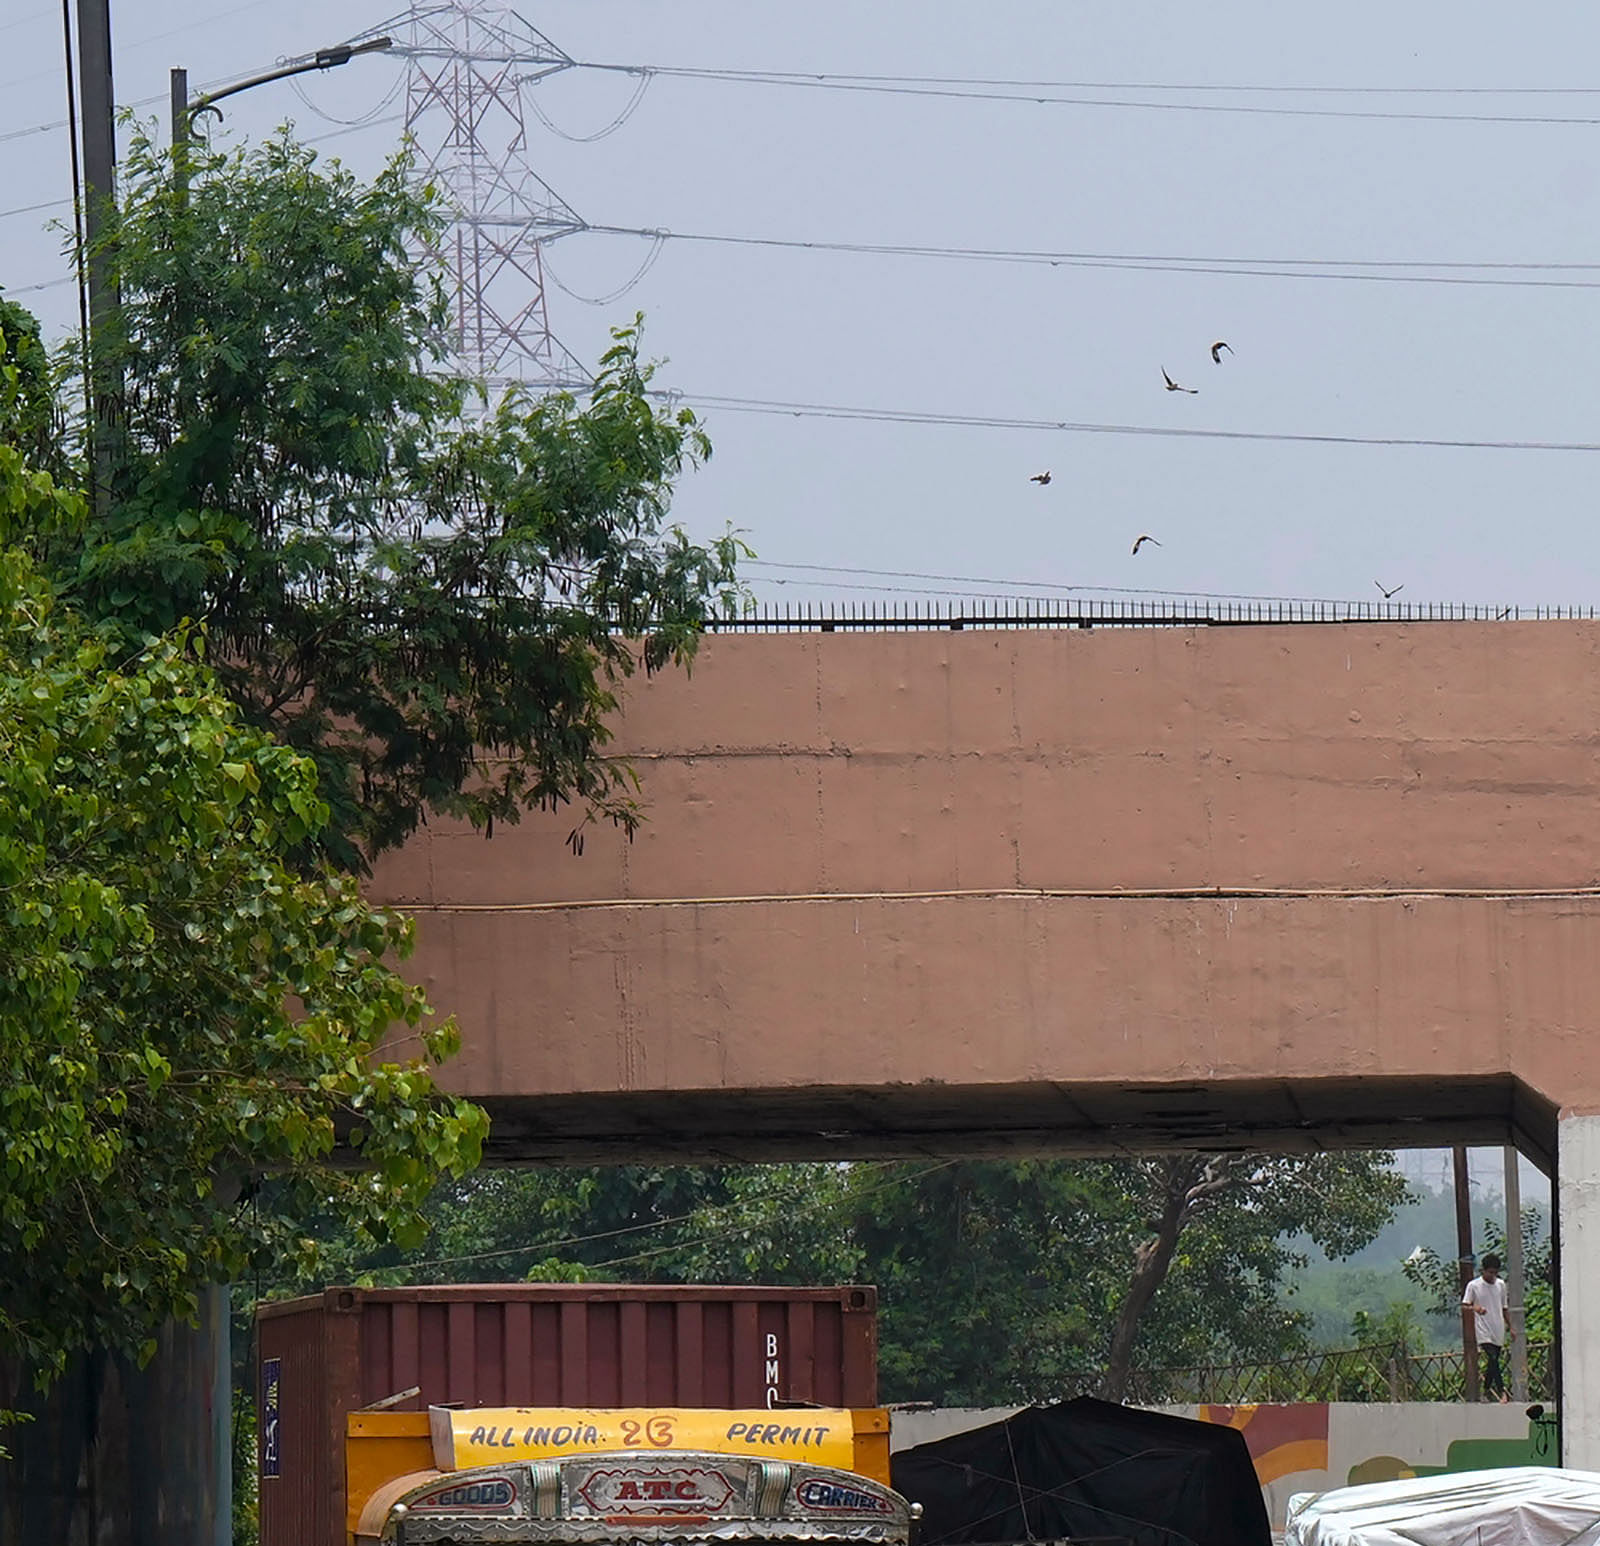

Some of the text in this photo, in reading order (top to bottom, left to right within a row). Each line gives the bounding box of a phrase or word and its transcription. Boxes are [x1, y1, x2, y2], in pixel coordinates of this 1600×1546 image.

[469, 1426, 516, 1447] ALL
[522, 1425, 597, 1446] INDIA
[726, 1422, 830, 1448] PERMIT
[440, 1482, 507, 1505] GOODS
[805, 1483, 876, 1508] CARRIER
